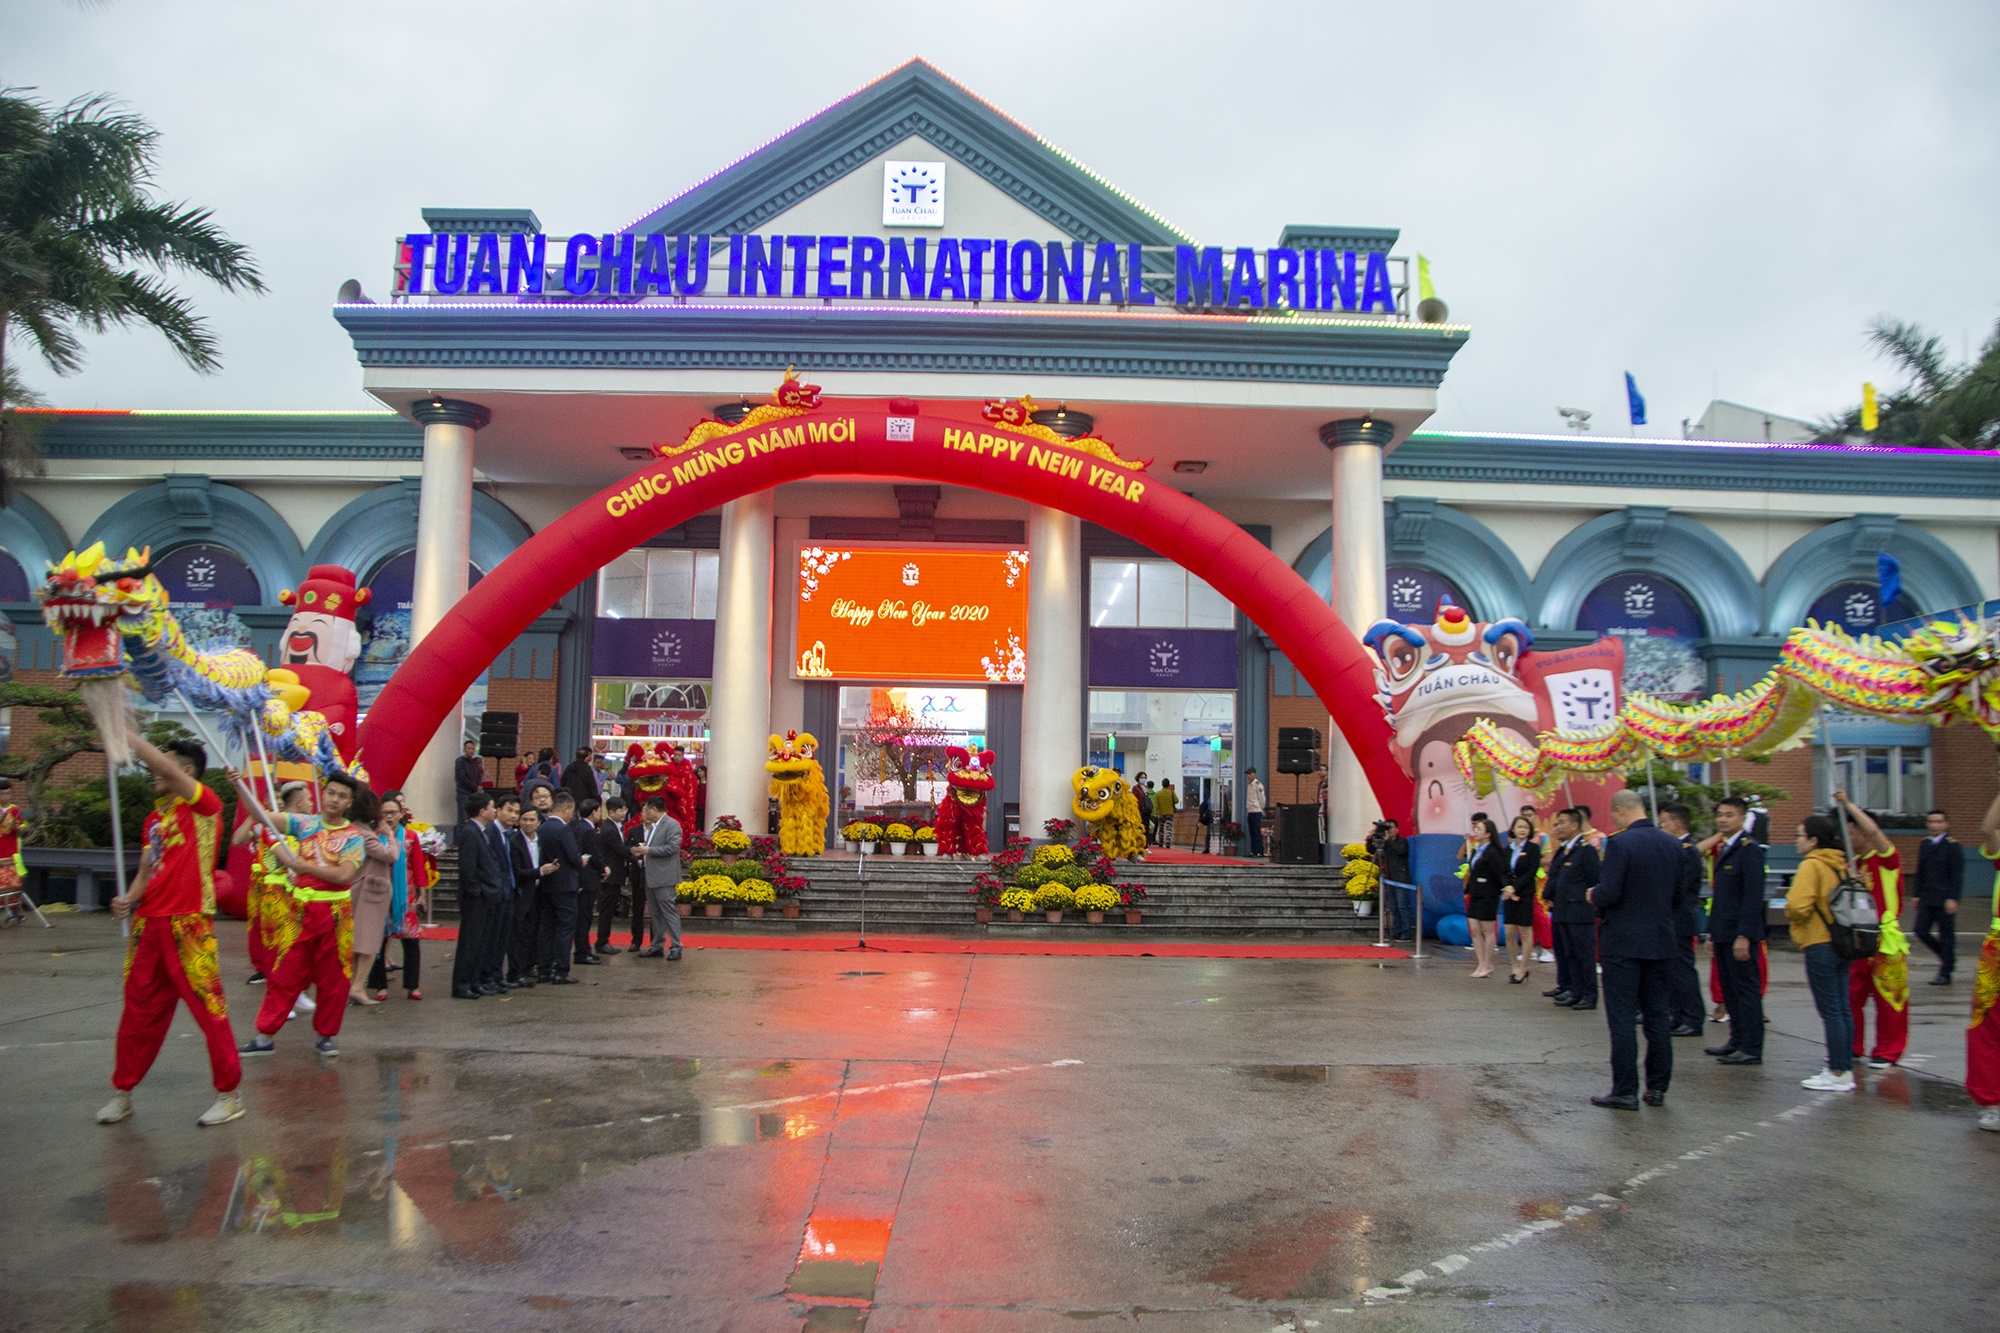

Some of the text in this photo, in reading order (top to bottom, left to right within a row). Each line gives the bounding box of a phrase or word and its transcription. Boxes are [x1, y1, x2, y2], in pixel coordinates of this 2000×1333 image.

[405, 233, 1397, 313] TUAN CHAU INTERNATIONAL MARINA
[606, 417, 856, 518] CHÚC MỪNG NĂM MỚI
[943, 427, 1145, 503] HAPPY NEW YEAR
[830, 598, 989, 626] Happy New Year 2020
